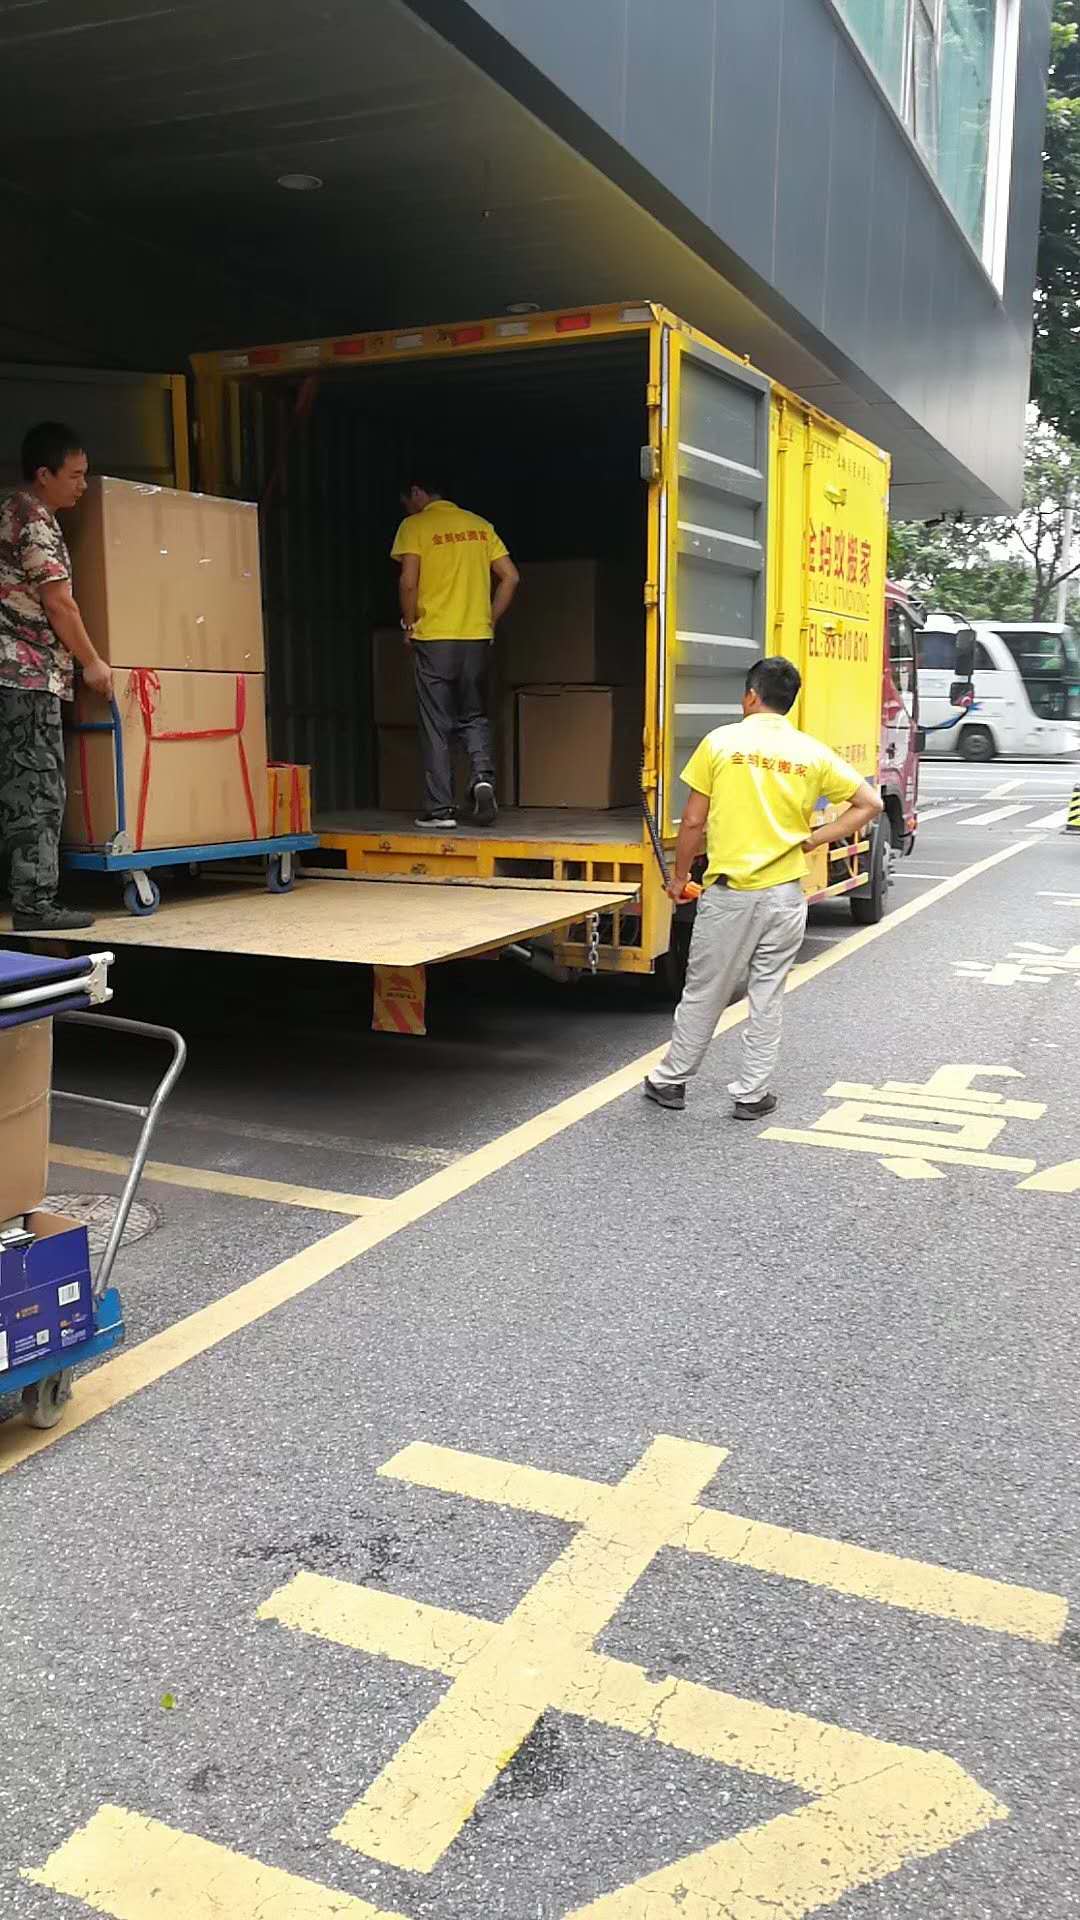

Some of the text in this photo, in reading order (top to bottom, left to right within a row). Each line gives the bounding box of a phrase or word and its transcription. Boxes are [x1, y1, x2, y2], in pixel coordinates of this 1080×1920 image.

[731, 752, 808, 777] 金蚂蚁搬家
